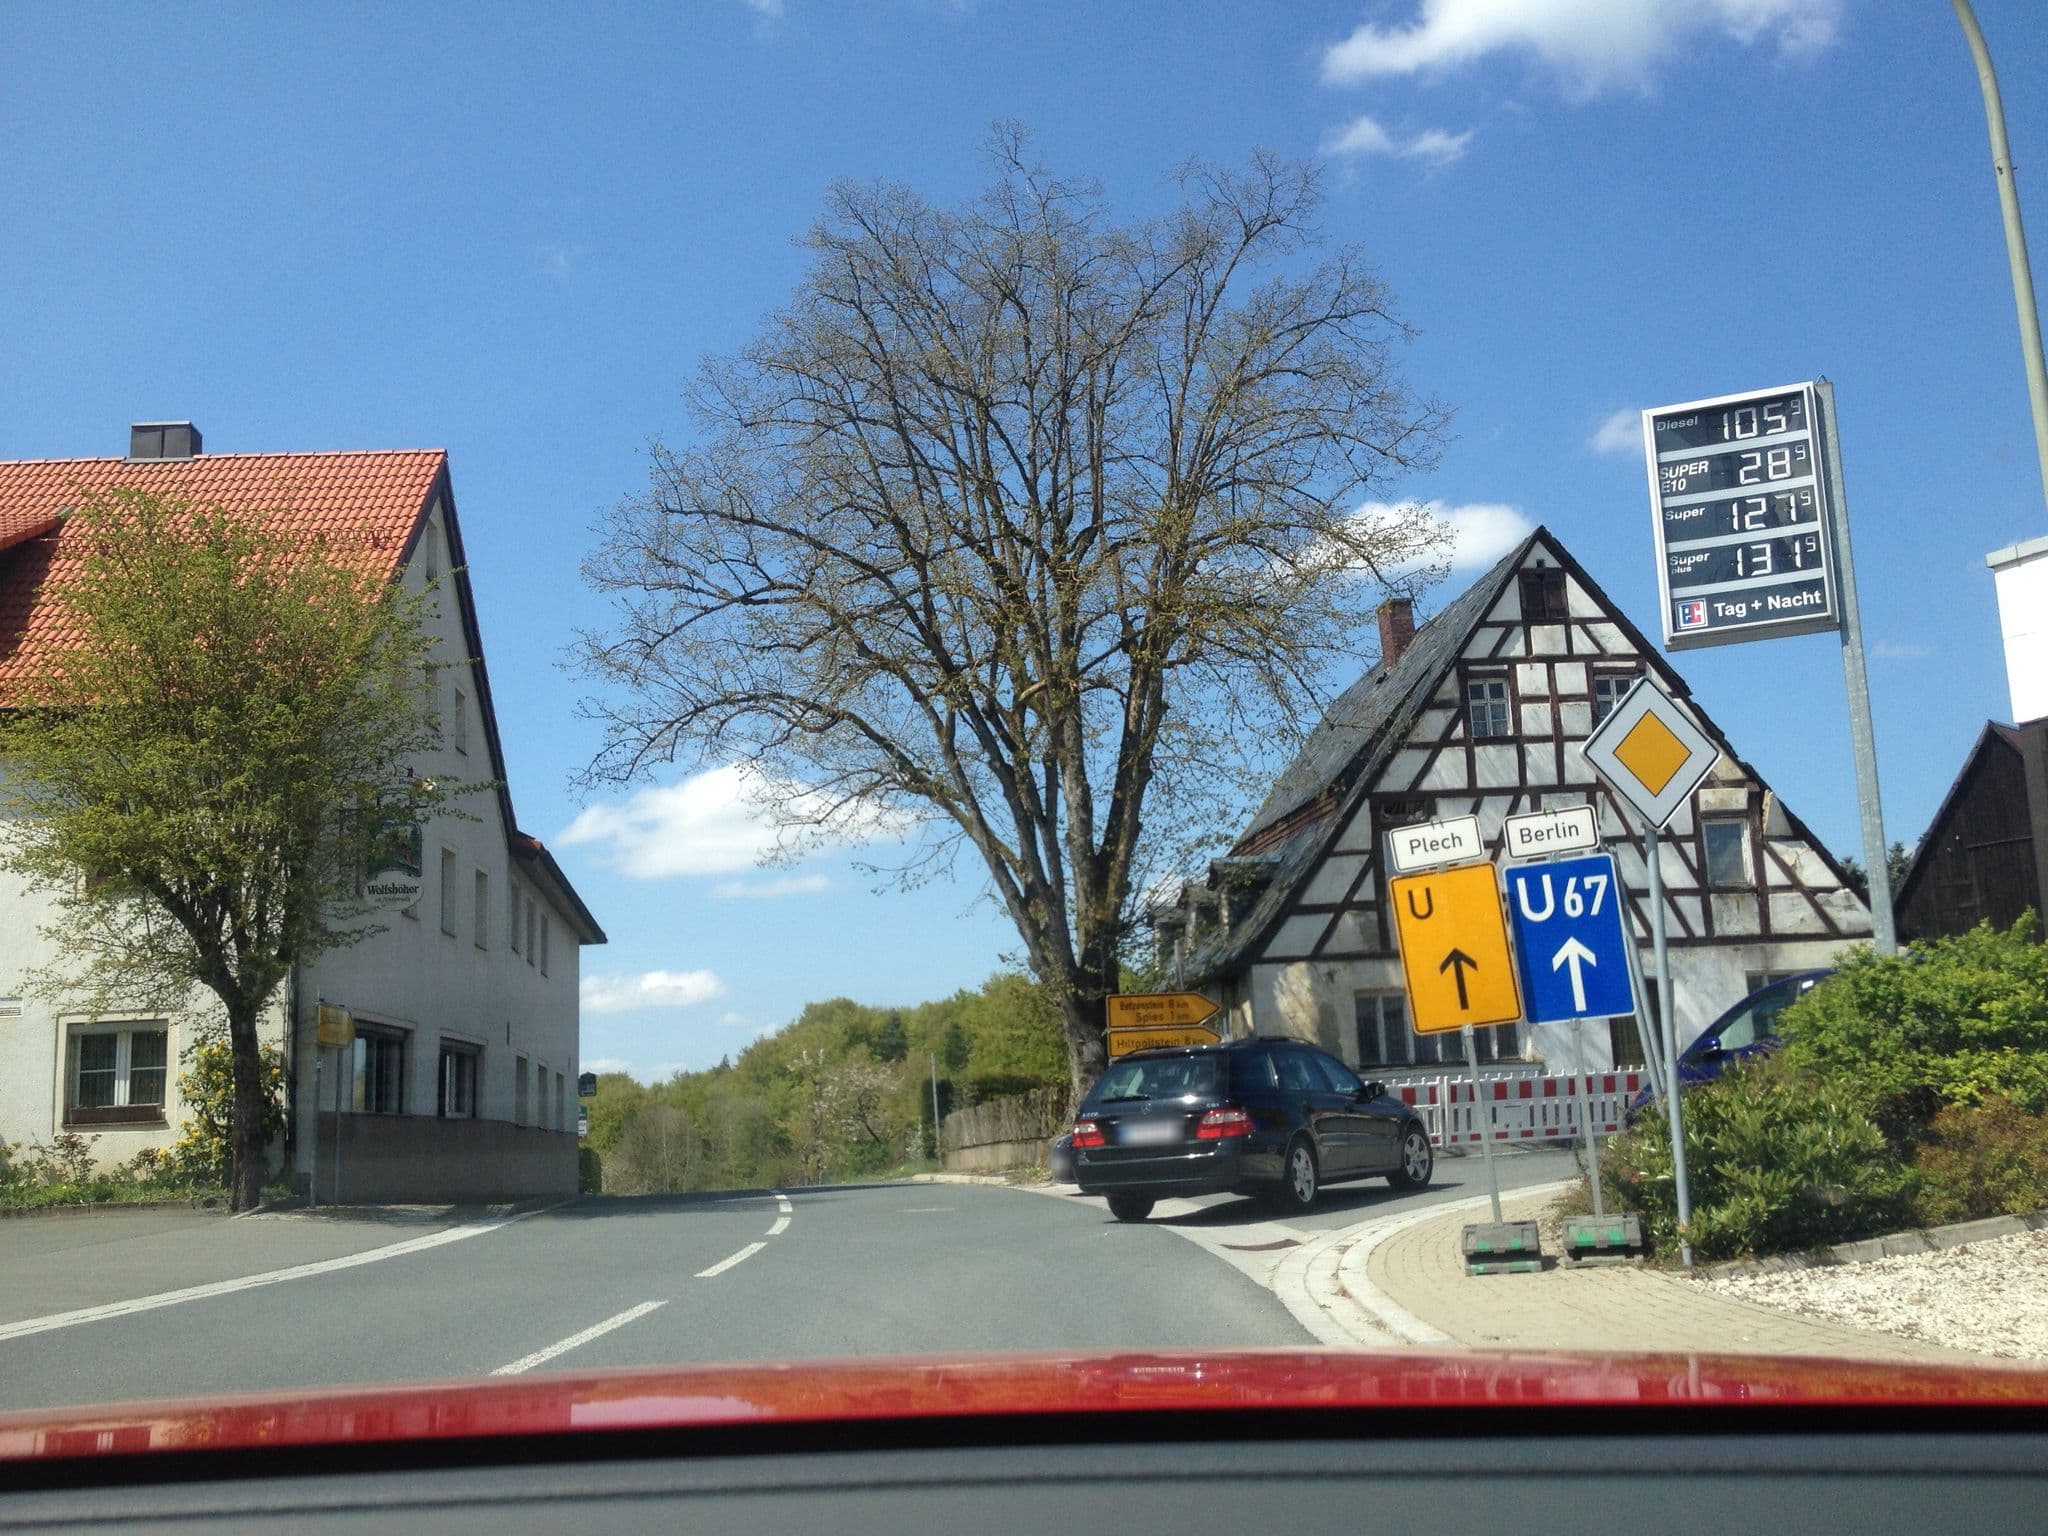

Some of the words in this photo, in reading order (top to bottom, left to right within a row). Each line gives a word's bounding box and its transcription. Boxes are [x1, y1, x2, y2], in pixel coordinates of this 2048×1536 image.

[1656, 415, 1698, 432] Diesel
[1660, 461, 1709, 480] SUPER
[1660, 480, 1687, 493] E10
[1665, 507, 1706, 521] Super
[1670, 552, 1711, 566] Super
[1671, 566, 1692, 575] plus
[1713, 602, 1747, 618] Tag
[1751, 601, 1762, 611] +
[1767, 590, 1823, 611] Nacht
[1519, 822, 1580, 844] Berlin
[1409, 832, 1463, 855] Plech
[367, 882, 420, 895] Wolfshöher
[1408, 887, 1434, 920] U
[1516, 874, 1556, 922] U
[1563, 874, 1609, 918] 67
[1168, 999, 1175, 1009] 8
[1136, 1012, 1164, 1024] Spies
